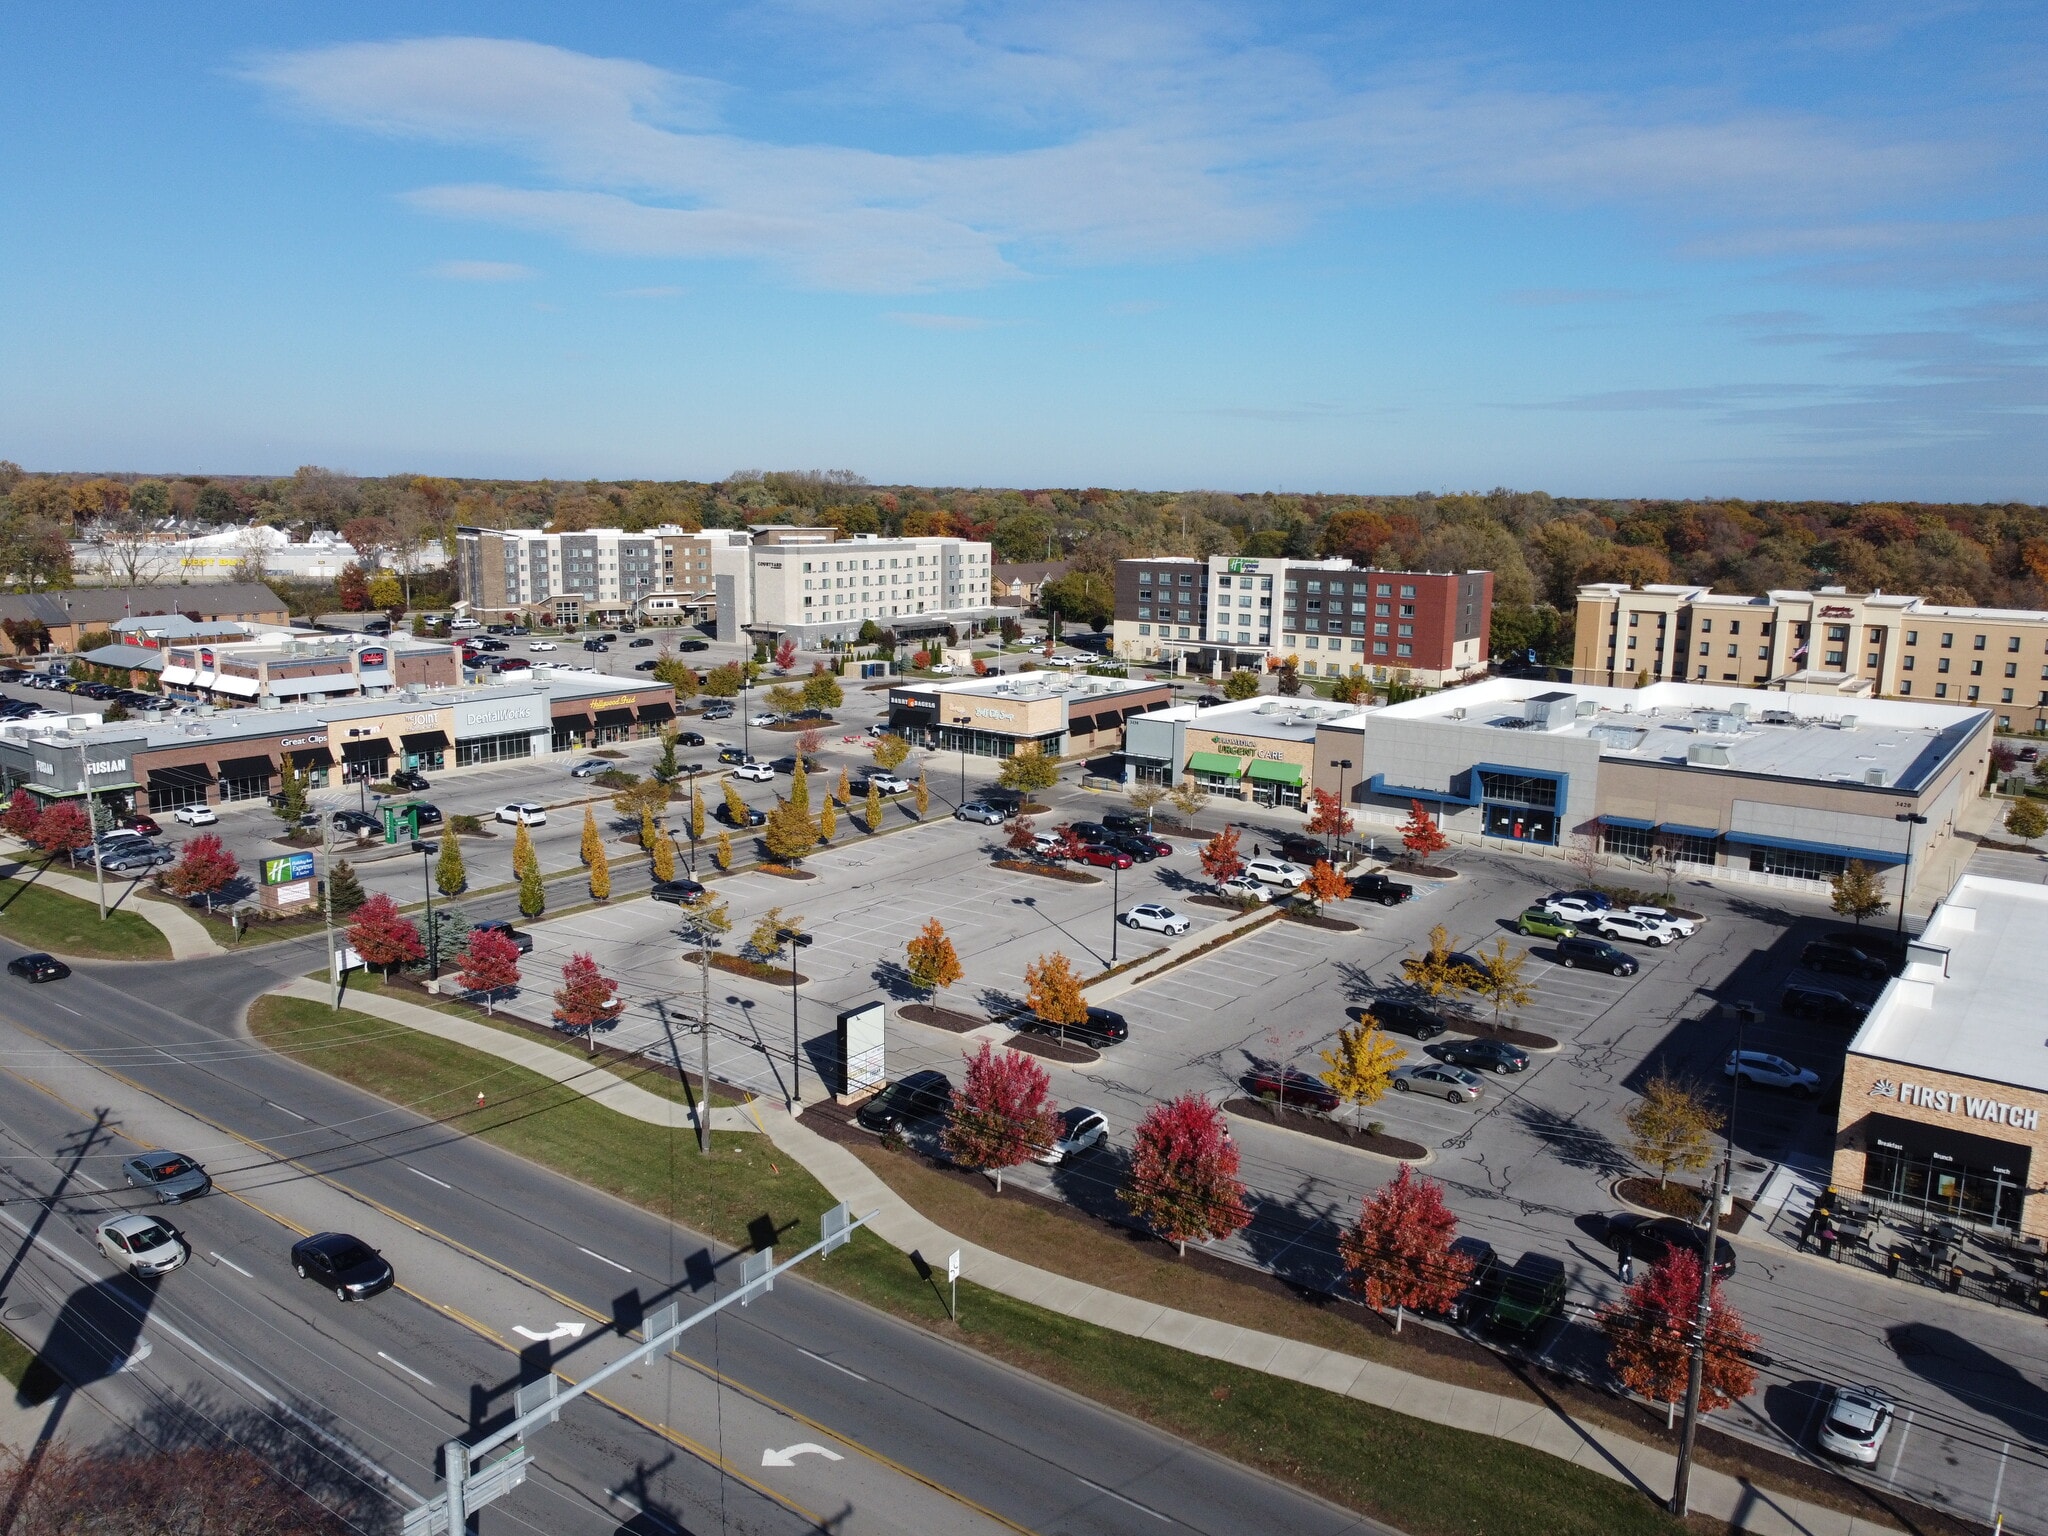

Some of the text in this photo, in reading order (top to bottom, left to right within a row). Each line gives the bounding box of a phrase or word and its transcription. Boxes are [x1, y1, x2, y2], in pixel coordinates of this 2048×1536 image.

[413, 712, 438, 726] JOINT
[467, 707, 530, 725] DentalWorks
[281, 735, 328, 747] Great Clips
[1218, 744, 1284, 760] URGENT CARE
[36, 760, 55, 776] FUSIAN
[87, 759, 127, 776] FUSIAN
[1900, 1082, 2040, 1132] FIRST WATCH
[1877, 1138, 1903, 1151] Breakfast
[1933, 1151, 1954, 1162] Brunch
[1992, 1165, 2011, 1175] Lunch
